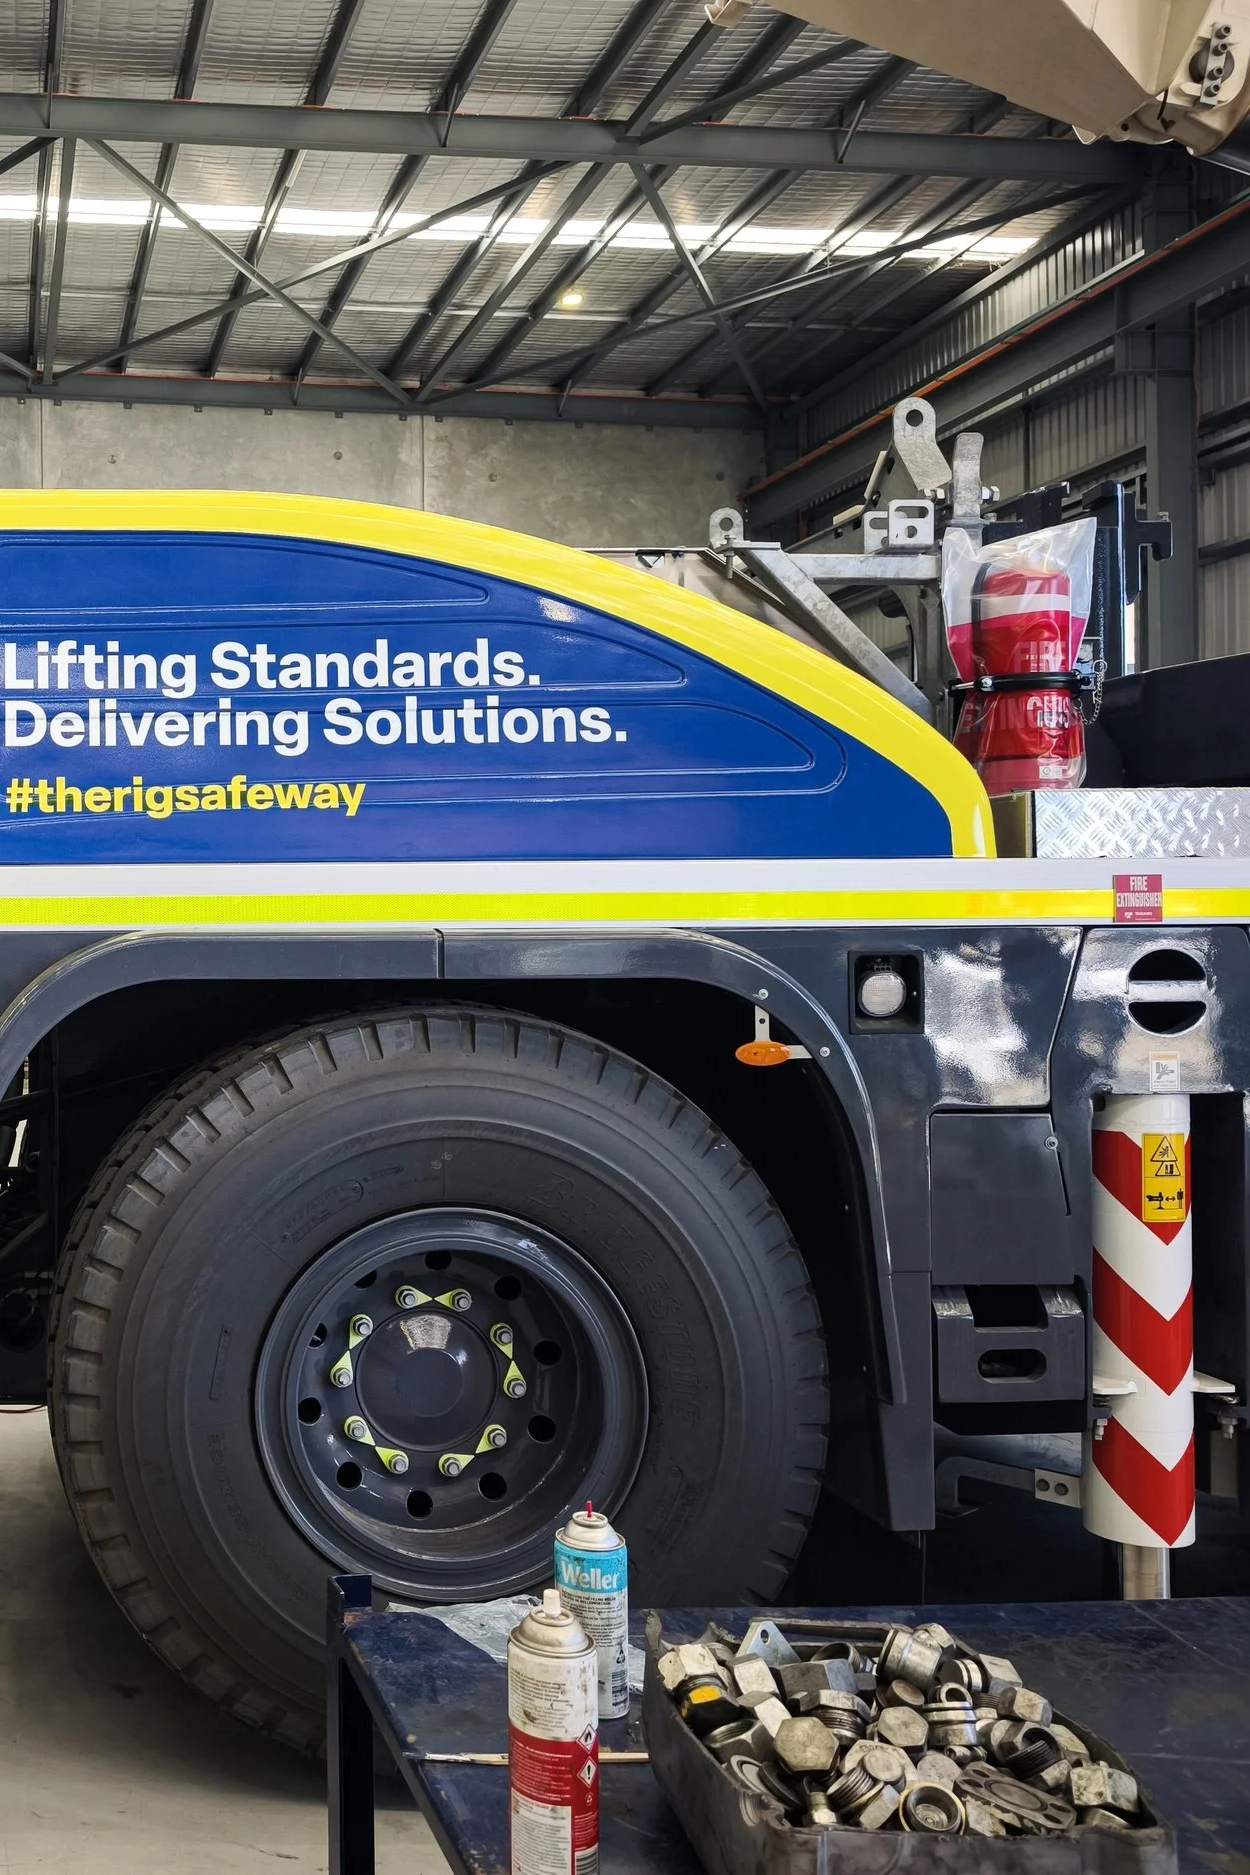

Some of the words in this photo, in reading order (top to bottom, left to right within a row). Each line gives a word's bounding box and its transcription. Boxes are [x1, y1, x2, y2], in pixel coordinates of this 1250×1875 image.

[4, 640, 196, 699] Lifting
[211, 638, 540, 690] Standards.
[4, 698, 309, 756] Delivering
[324, 695, 627, 746] Solutions.
[6, 775, 366, 819] #therigsafeway
[1116, 892, 1162, 908] EXTINGUISHER
[1129, 876, 1148, 891] FIRE
[561, 1558, 620, 1589] Weller
